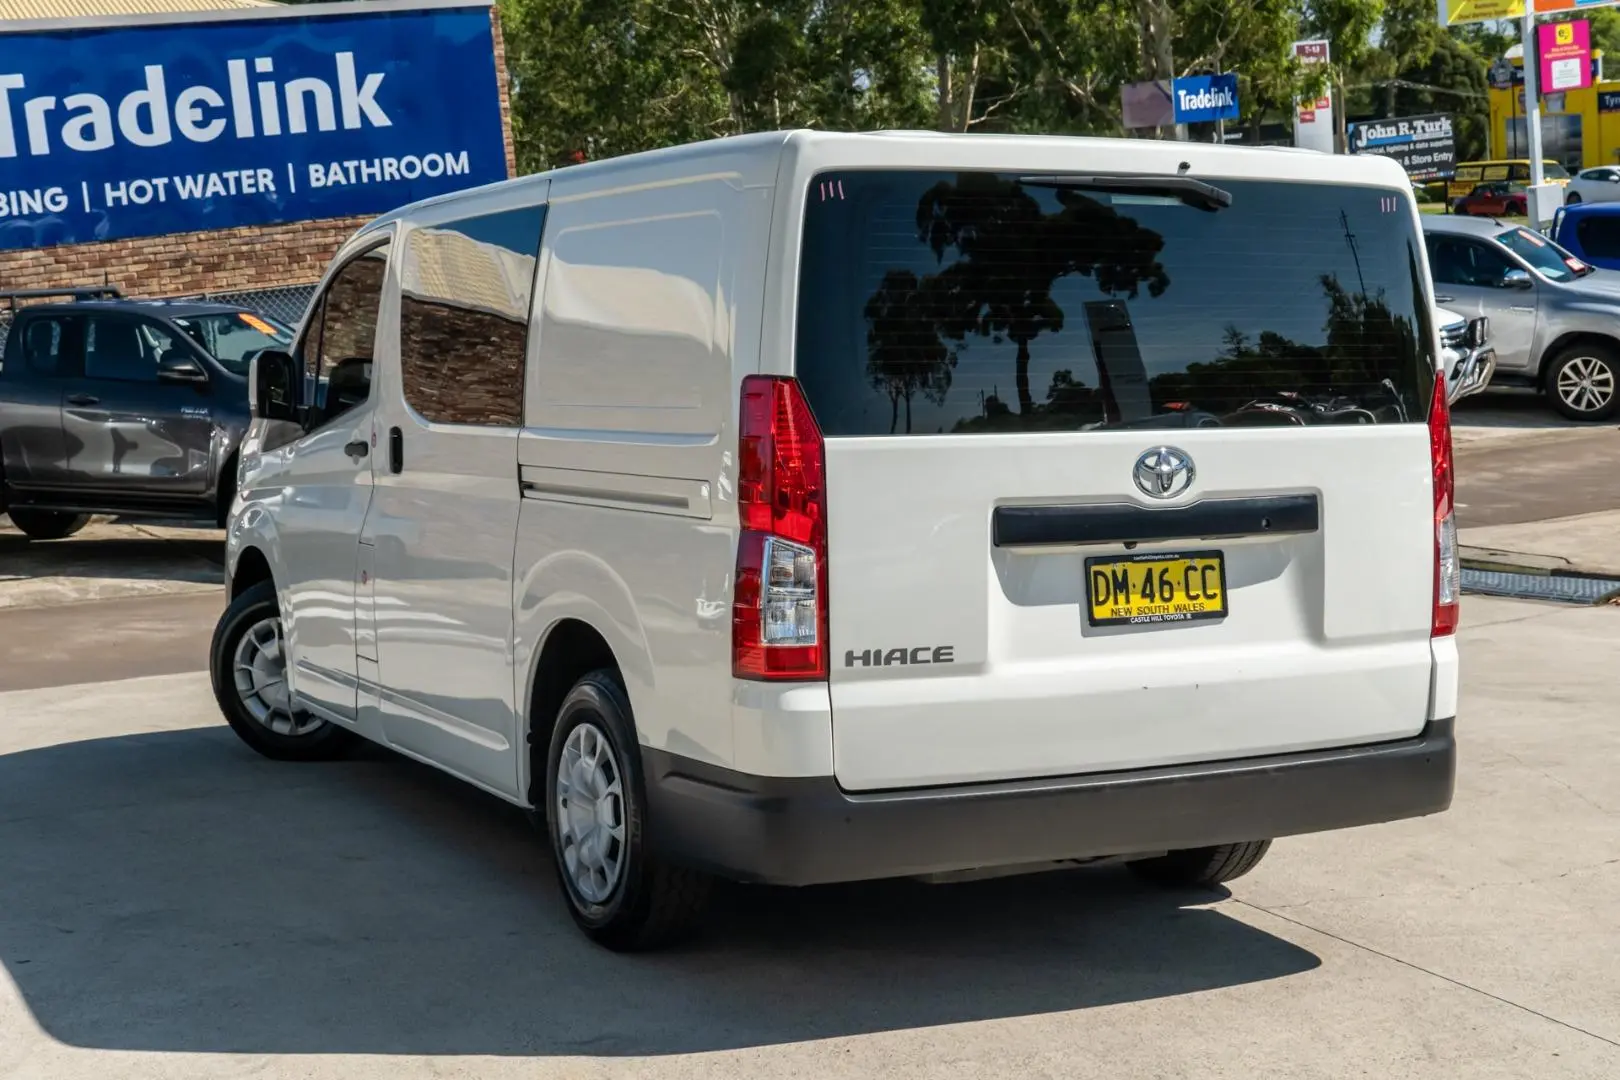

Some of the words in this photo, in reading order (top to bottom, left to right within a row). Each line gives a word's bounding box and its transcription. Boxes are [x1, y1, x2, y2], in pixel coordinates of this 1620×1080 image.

[0, 51, 393, 158] Tradelink
[1178, 86, 1234, 111] Tradelink
[1356, 123, 1397, 147] John
[1413, 116, 1452, 134] Turk
[1404, 156, 1410, 165] &
[1411, 154, 1432, 165] Store
[1433, 152, 1453, 162] Entry
[104, 176, 169, 207] HOT
[173, 167, 276, 201] WATER
[308, 150, 470, 189] BATHROOM
[1110, 606, 1132, 617] NEW
[1137, 604, 1170, 615] SOUTH
[1174, 602, 1205, 613] WALES
[1130, 616, 1150, 624] CASTLE
[845, 645, 954, 667] HIACE
